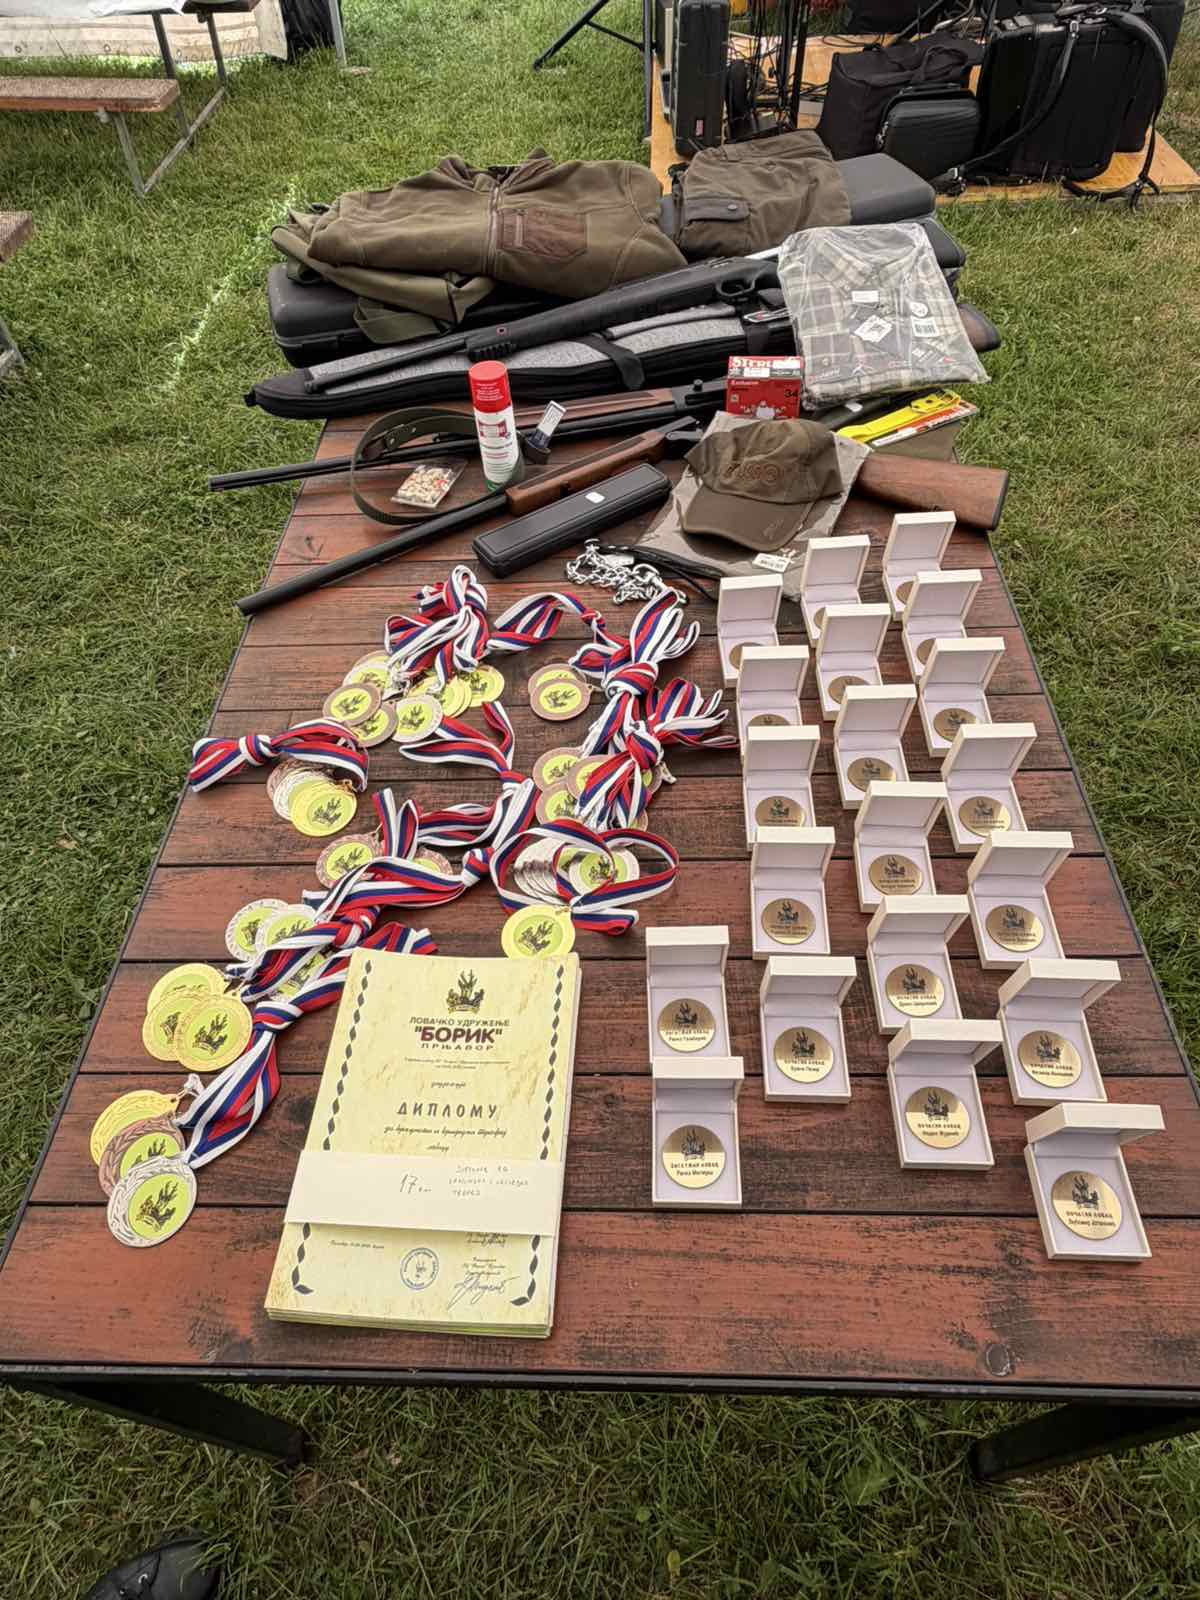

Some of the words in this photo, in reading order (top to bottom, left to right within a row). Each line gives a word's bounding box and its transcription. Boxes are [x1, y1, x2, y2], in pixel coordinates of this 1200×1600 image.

[409, 1016, 455, 1026] ЛОВАЧКО
[456, 1018, 511, 1028] УДРУЖЕЊЕ
[414, 1025, 503, 1044] "БОРИК"
[421, 1042, 494, 1051] ПРЊАВОР
[396, 1101, 498, 1119] ДИПЛОМУ
[399, 1173, 419, 1195] 17
